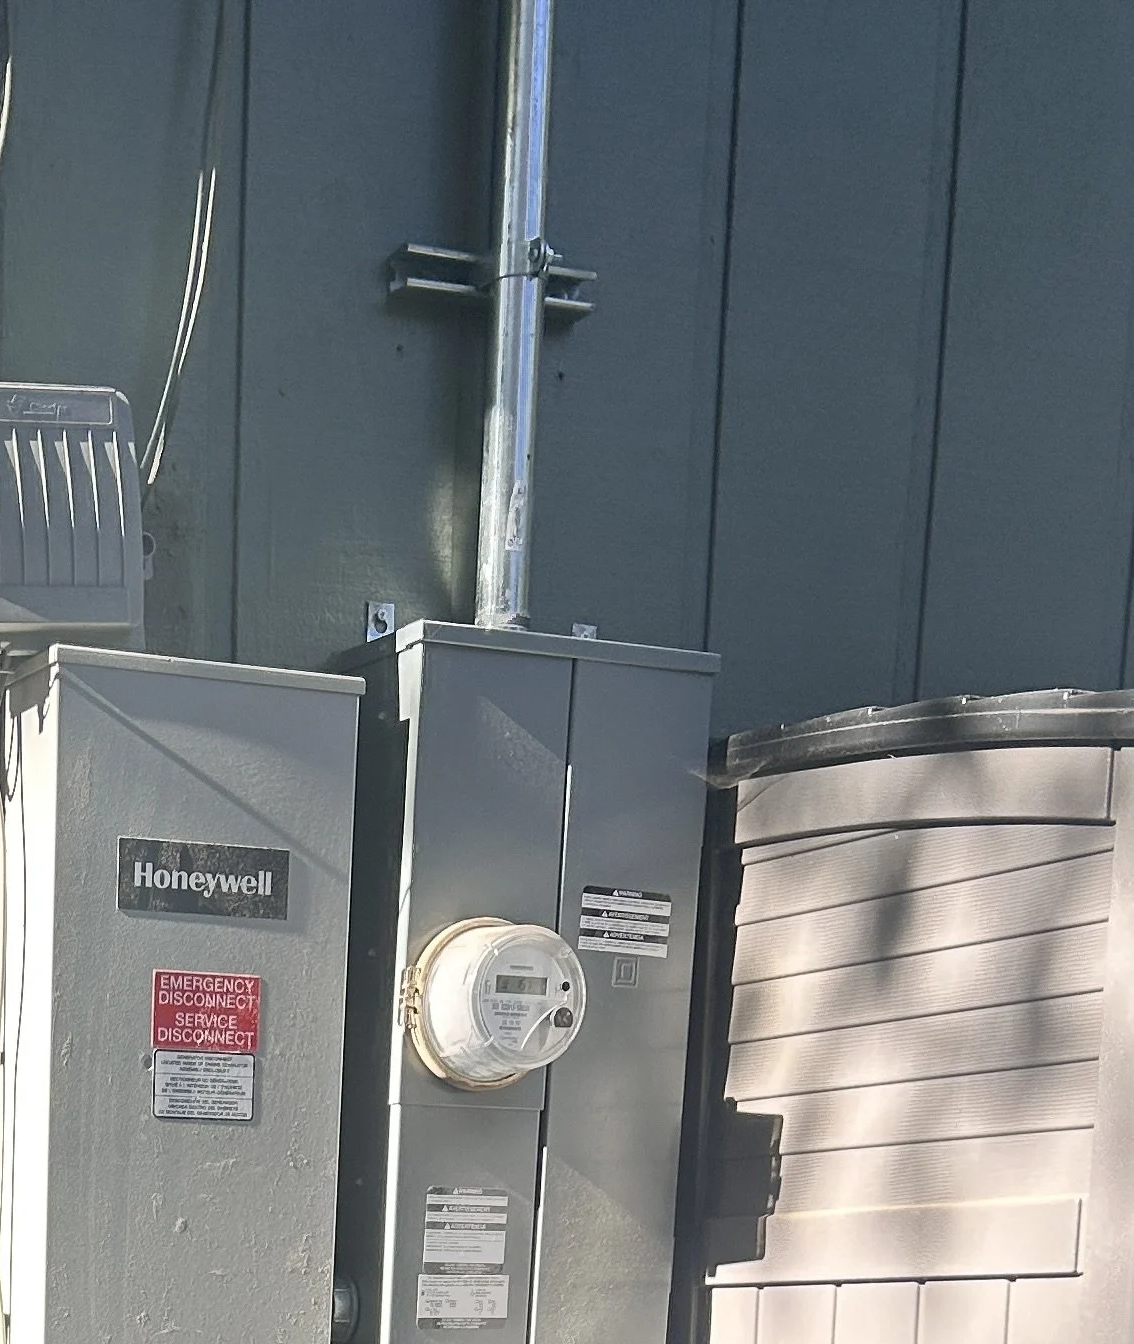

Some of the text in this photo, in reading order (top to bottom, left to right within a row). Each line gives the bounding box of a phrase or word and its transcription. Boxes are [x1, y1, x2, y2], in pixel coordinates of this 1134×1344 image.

[134, 861, 273, 898] Honeywell
[160, 974, 255, 994] EMERGENCY
[158, 990, 257, 1011] DISCONNECT
[175, 1012, 238, 1030] SERVICE
[157, 1027, 255, 1048] DISCONNECT
